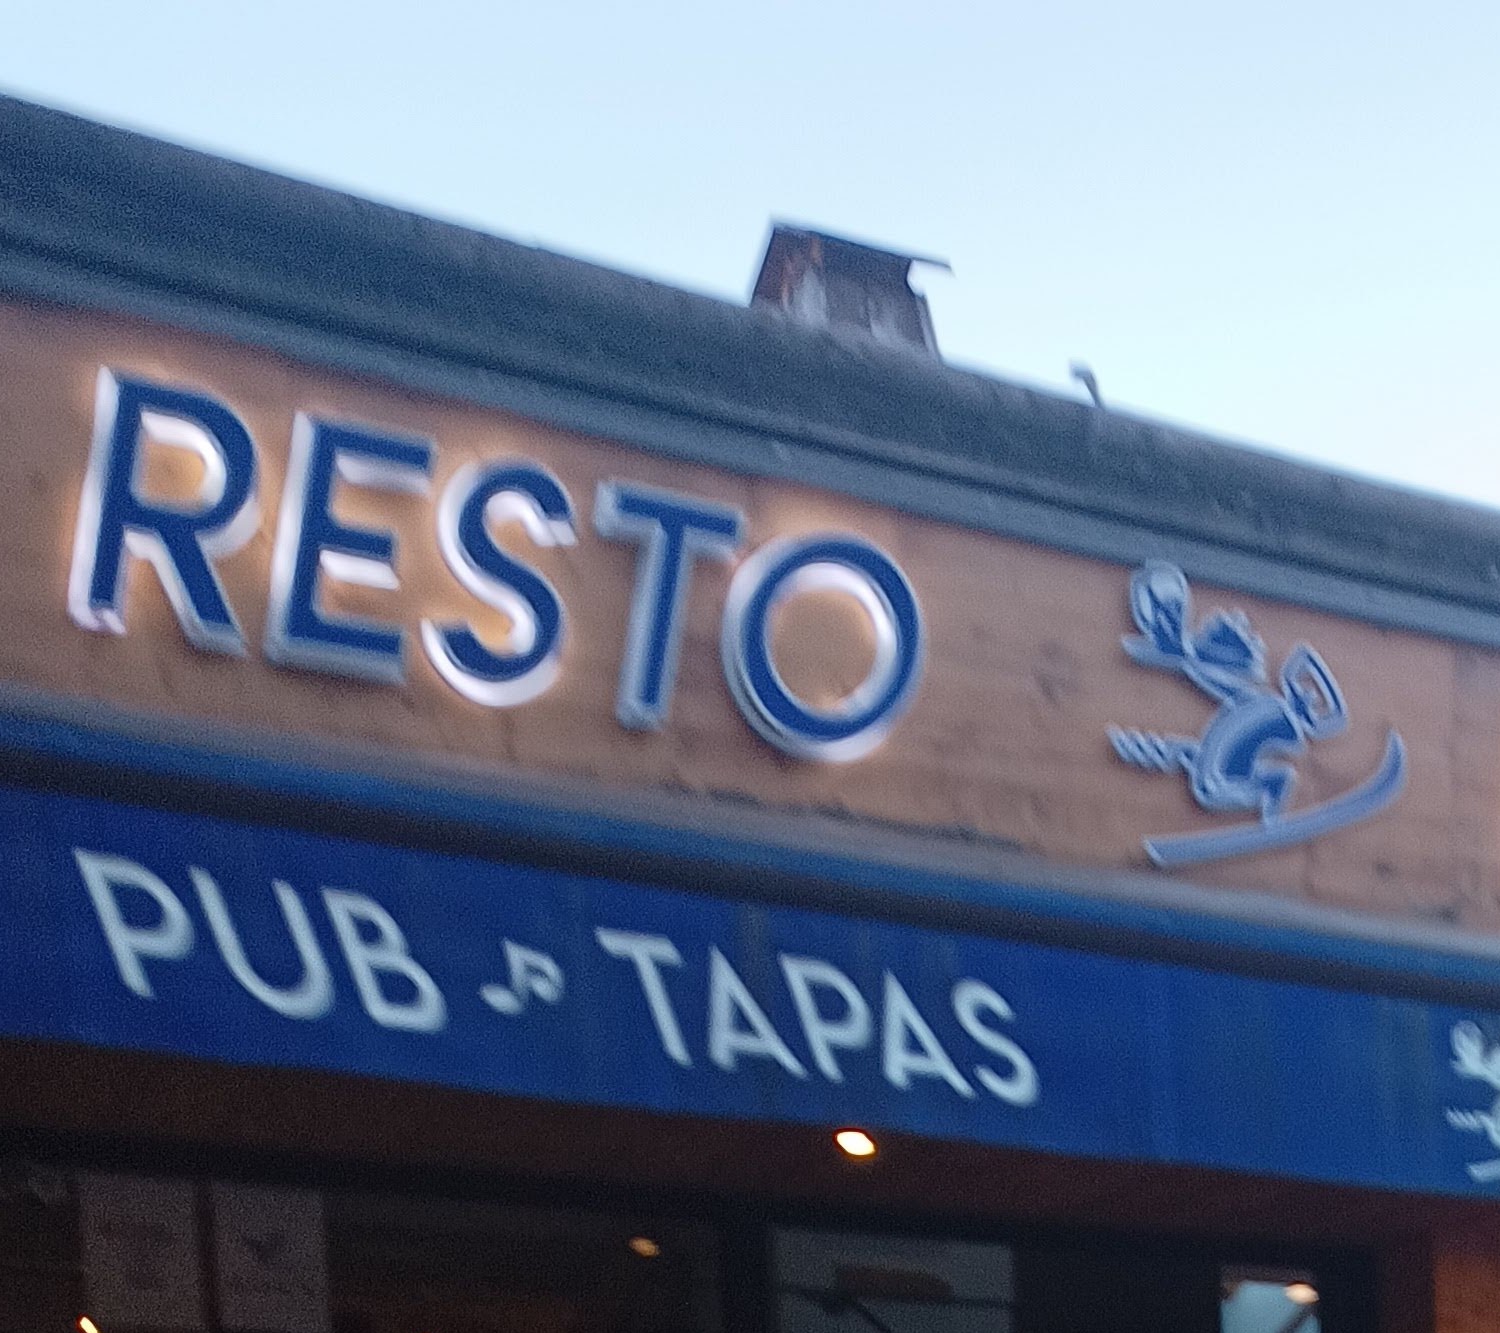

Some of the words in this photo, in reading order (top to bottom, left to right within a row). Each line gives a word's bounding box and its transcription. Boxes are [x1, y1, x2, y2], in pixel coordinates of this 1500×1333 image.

[68, 361, 928, 763] RESTO
[73, 846, 448, 1034] PUB
[598, 926, 1041, 1109] TAPAS
